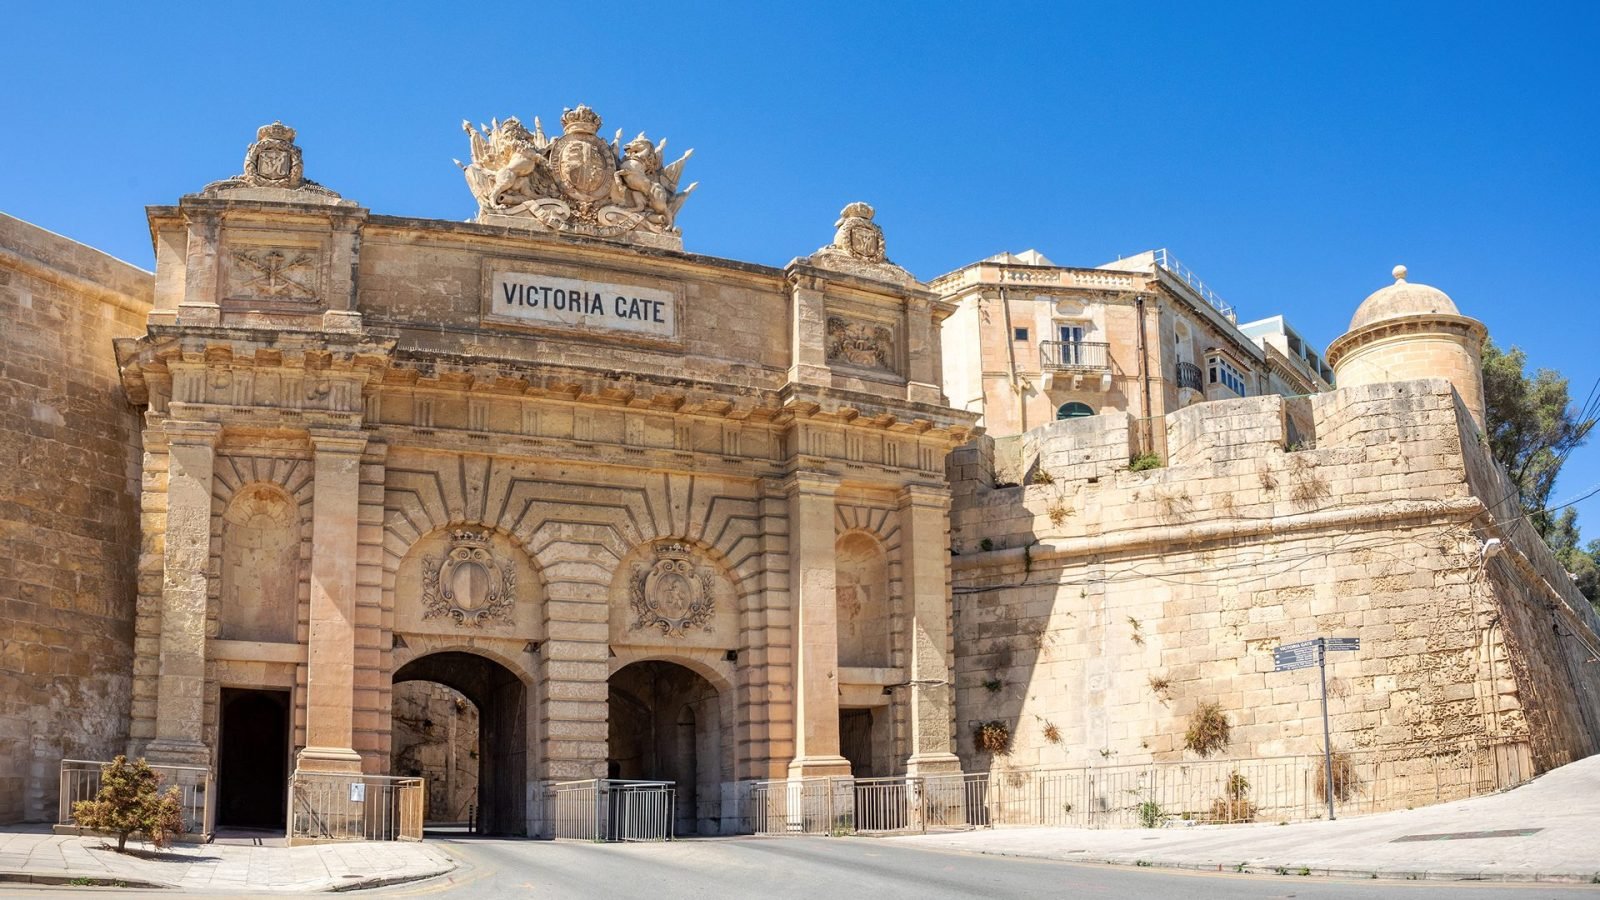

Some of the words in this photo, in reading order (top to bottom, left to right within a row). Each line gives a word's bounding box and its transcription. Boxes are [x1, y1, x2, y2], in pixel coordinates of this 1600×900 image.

[503, 282, 604, 315] VICTORIA
[615, 296, 665, 323] GATE
[1279, 643, 1300, 651] VICTORIA
